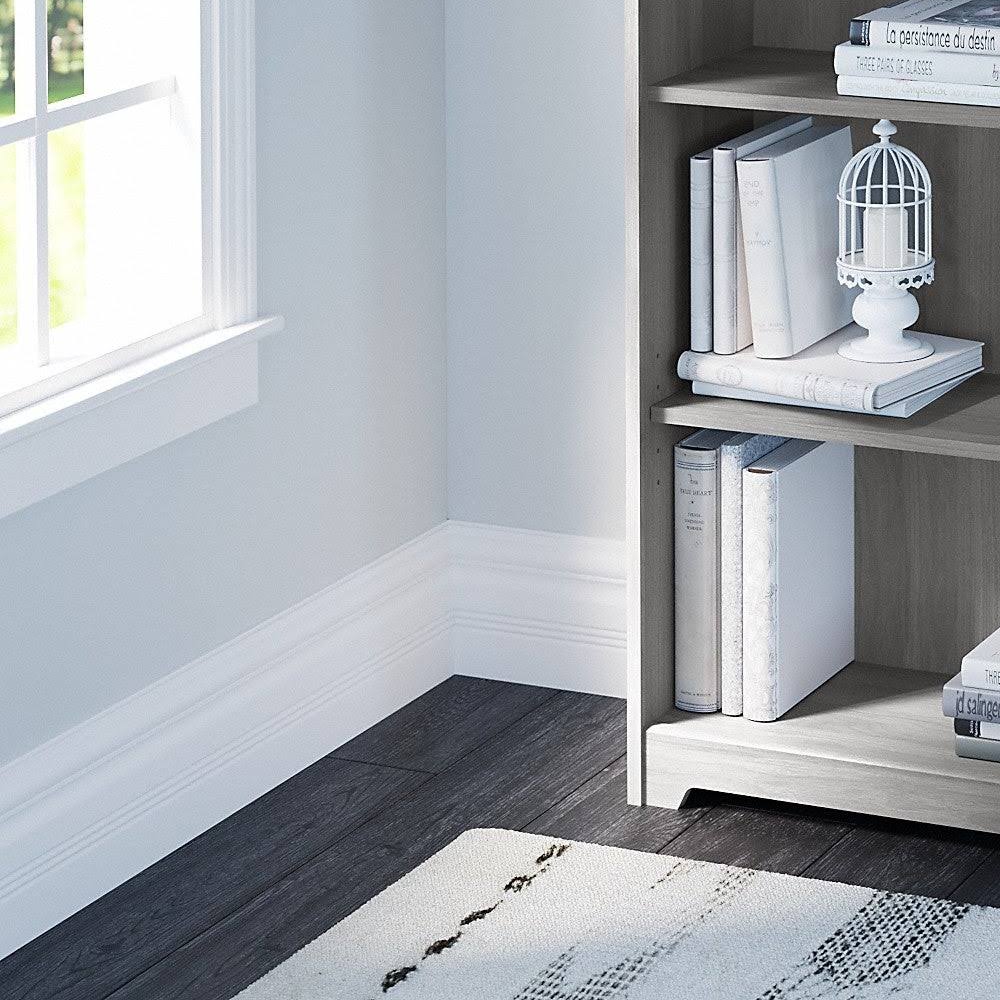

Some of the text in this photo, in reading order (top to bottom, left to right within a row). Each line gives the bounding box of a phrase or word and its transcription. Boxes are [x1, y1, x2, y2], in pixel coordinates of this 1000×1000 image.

[887, 22, 896, 44] La
[899, 24, 951, 49] persistance
[954, 26, 966, 49] du
[968, 27, 996, 51] destin
[856, 56, 933, 76] THREE PAIRS OF GLASSES
[992, 63, 999, 81] by
[955, 690, 965, 717] jd
